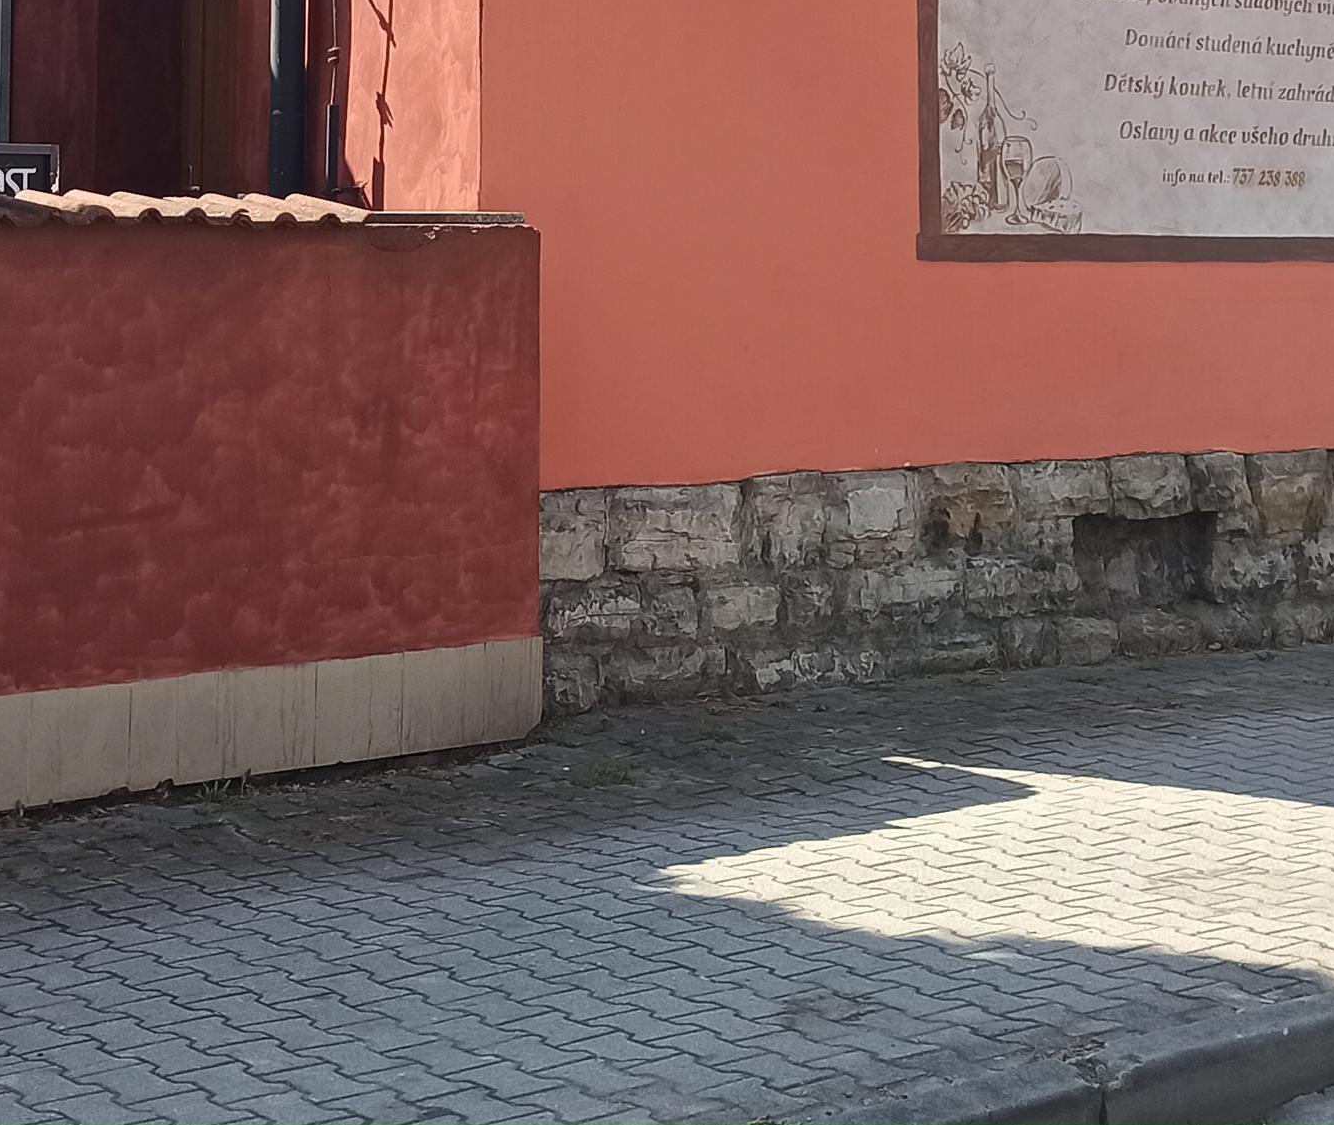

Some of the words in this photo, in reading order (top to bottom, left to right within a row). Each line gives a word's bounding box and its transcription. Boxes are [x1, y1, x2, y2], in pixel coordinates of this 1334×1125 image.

[1124, 28, 1191, 50] Domácí
[1195, 34, 1262, 55] studená
[1104, 73, 1165, 99] Dětský
[1168, 76, 1231, 100] koutek,
[1236, 79, 1274, 100] letní
[1119, 120, 1180, 146] Oslavy
[1184, 128, 1194, 141] a
[1199, 124, 1236, 145] akce
[1241, 126, 1289, 146] všeho
[1162, 168, 1187, 188] info
[1189, 172, 1205, 183] na
[1232, 168, 1256, 185] 737
[1258, 169, 1280, 187] 238
[1284, 170, 1306, 188] 388
